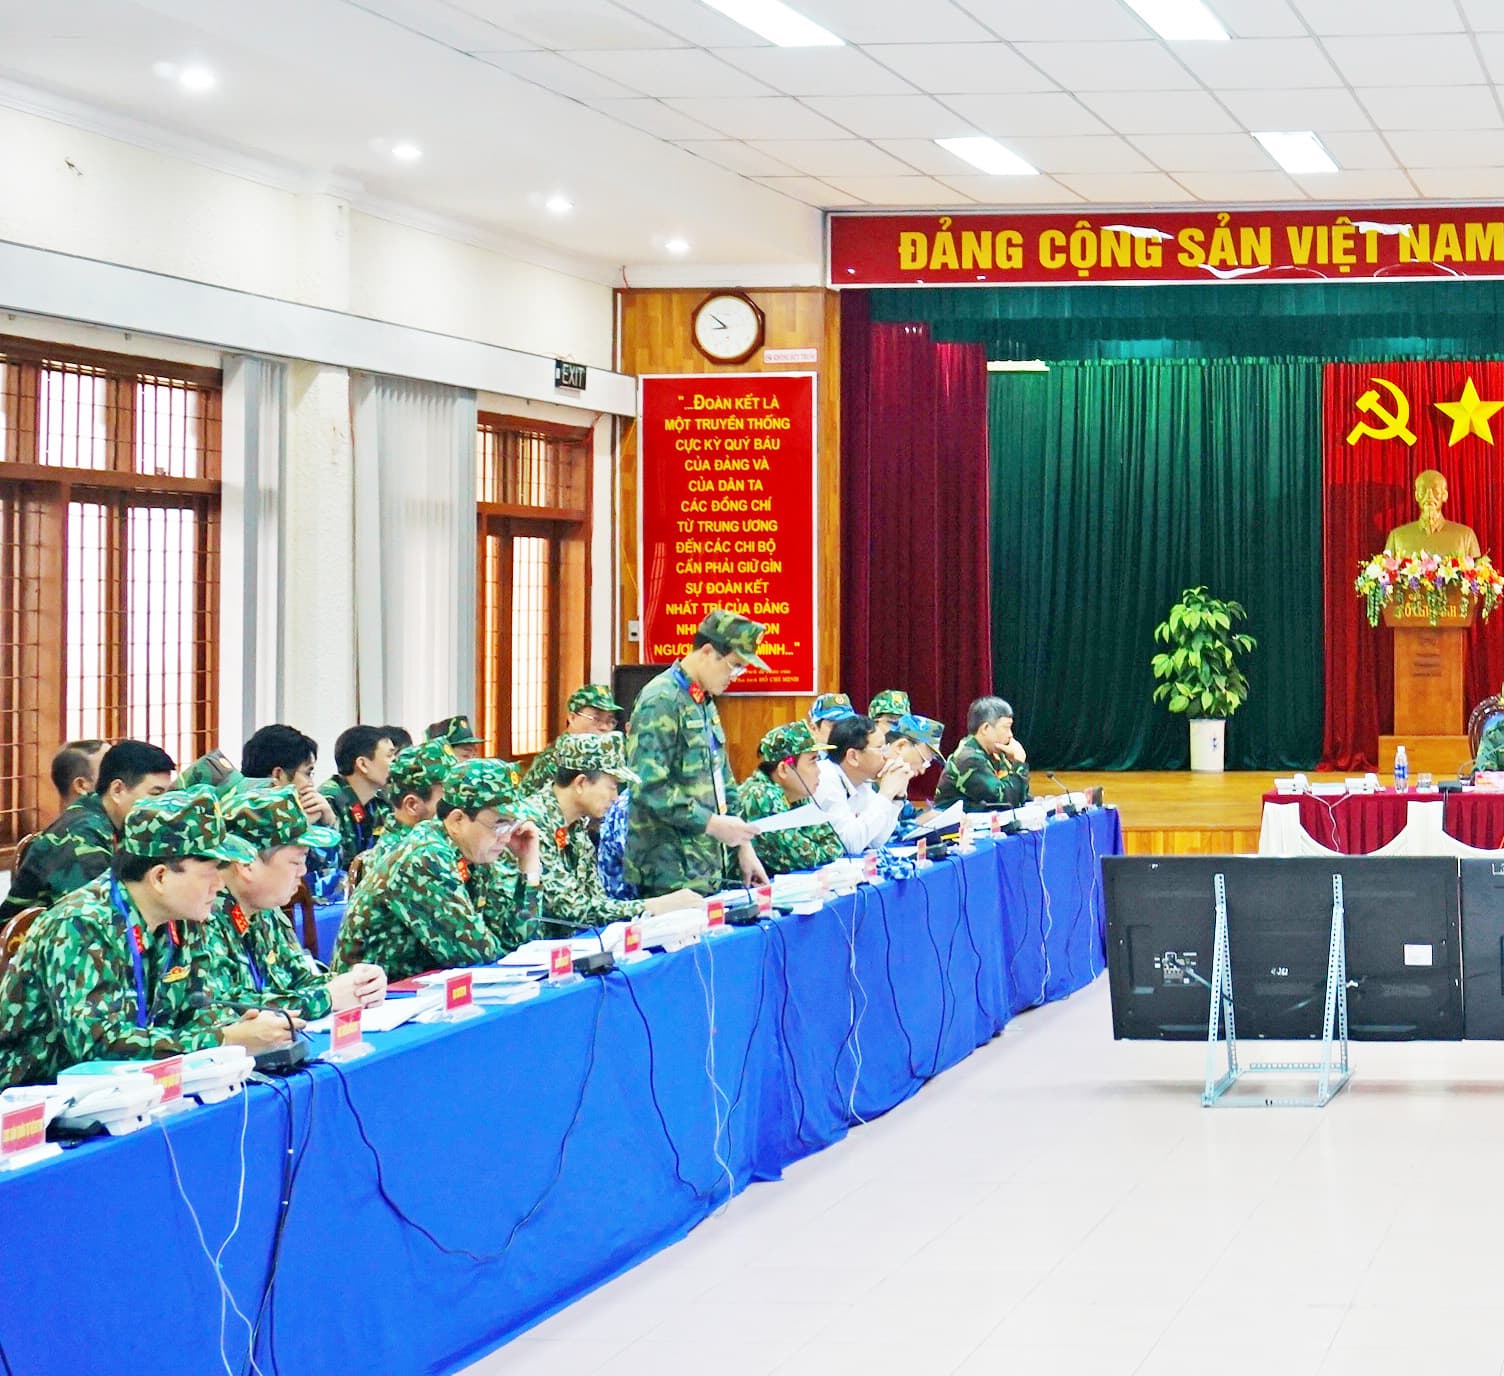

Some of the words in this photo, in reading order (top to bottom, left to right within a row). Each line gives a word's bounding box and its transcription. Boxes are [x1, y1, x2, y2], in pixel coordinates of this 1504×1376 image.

[898, 216, 1024, 270] ĐẢNG
[1038, 220, 1163, 277] CỘNG
[1177, 212, 1272, 268] SẢN
[1286, 216, 1382, 273] VIỆT
[1398, 222, 1504, 264] NAM
[562, 363, 584, 388] EXIT
[734, 392, 761, 410] KẾT
[762, 394, 780, 410] LÀ
[664, 415, 692, 434] MỘT
[675, 437, 702, 454] CỰC
[684, 455, 712, 472] CỦA
[713, 454, 751, 472] ĐẢNG
[752, 455, 770, 471] VÀ
[687, 475, 715, 493] CỦA
[717, 476, 745, 492] DÂN
[746, 478, 764, 492] TA
[680, 497, 708, 513] CÁC
[750, 495, 773, 512] CHÍ
[676, 518, 695, 534] TỪ
[696, 520, 740, 533] TRUNG
[741, 518, 779, 533] ƯƠNG
[675, 537, 703, 554] ĐẾN
[703, 537, 732, 553] CÁC
[734, 540, 756, 553] CHI
[757, 537, 777, 556] BỘ
[704, 557, 735, 574] PHẢI
[760, 557, 783, 574] GÌN
[684, 580, 704, 598] SỰ
[705, 578, 743, 595] ĐOÀN
[744, 577, 770, 594] KẾT
[665, 599, 699, 616] NHẤT
[753, 597, 790, 615] ĐẢNG
